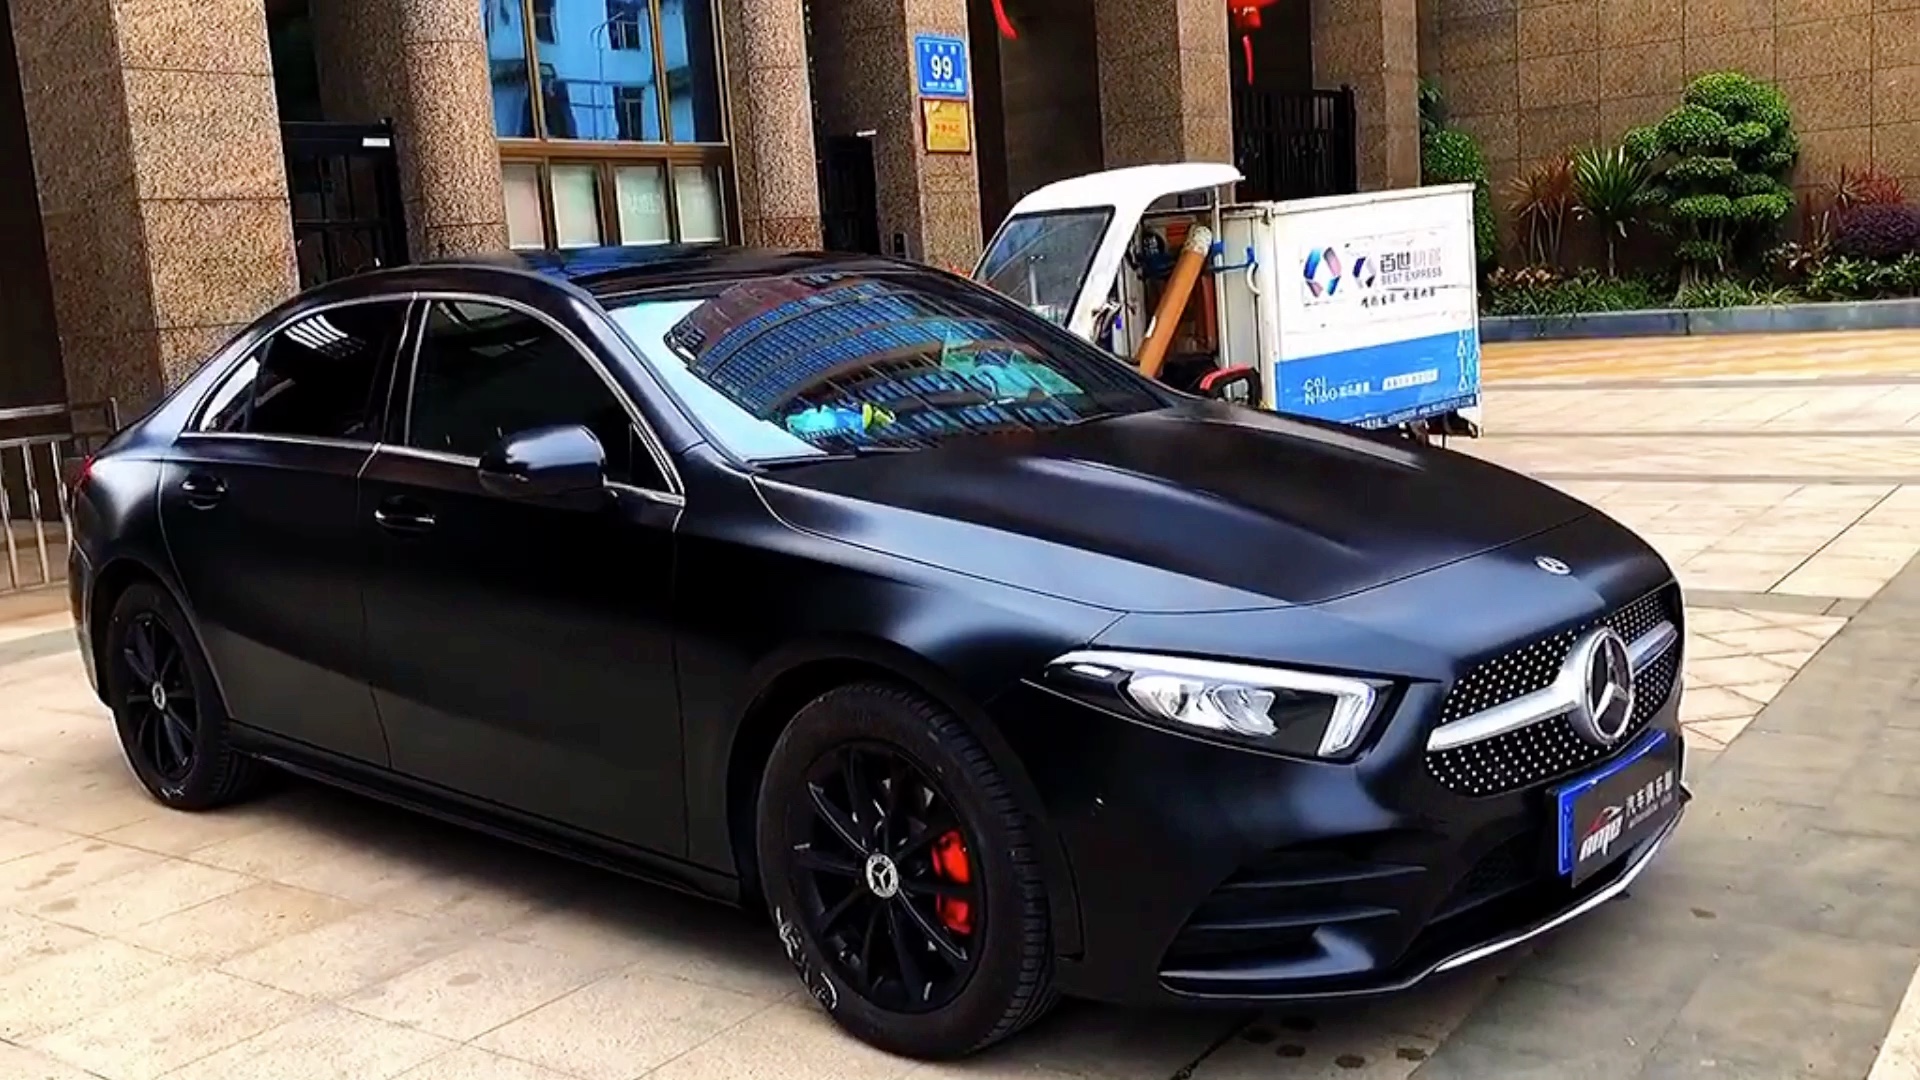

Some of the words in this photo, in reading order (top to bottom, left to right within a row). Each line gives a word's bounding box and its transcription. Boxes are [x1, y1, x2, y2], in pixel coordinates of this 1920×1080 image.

[931, 54, 953, 80] 99
[1381, 274, 1403, 285] BEST
[1405, 266, 1442, 282] EXPRESS
